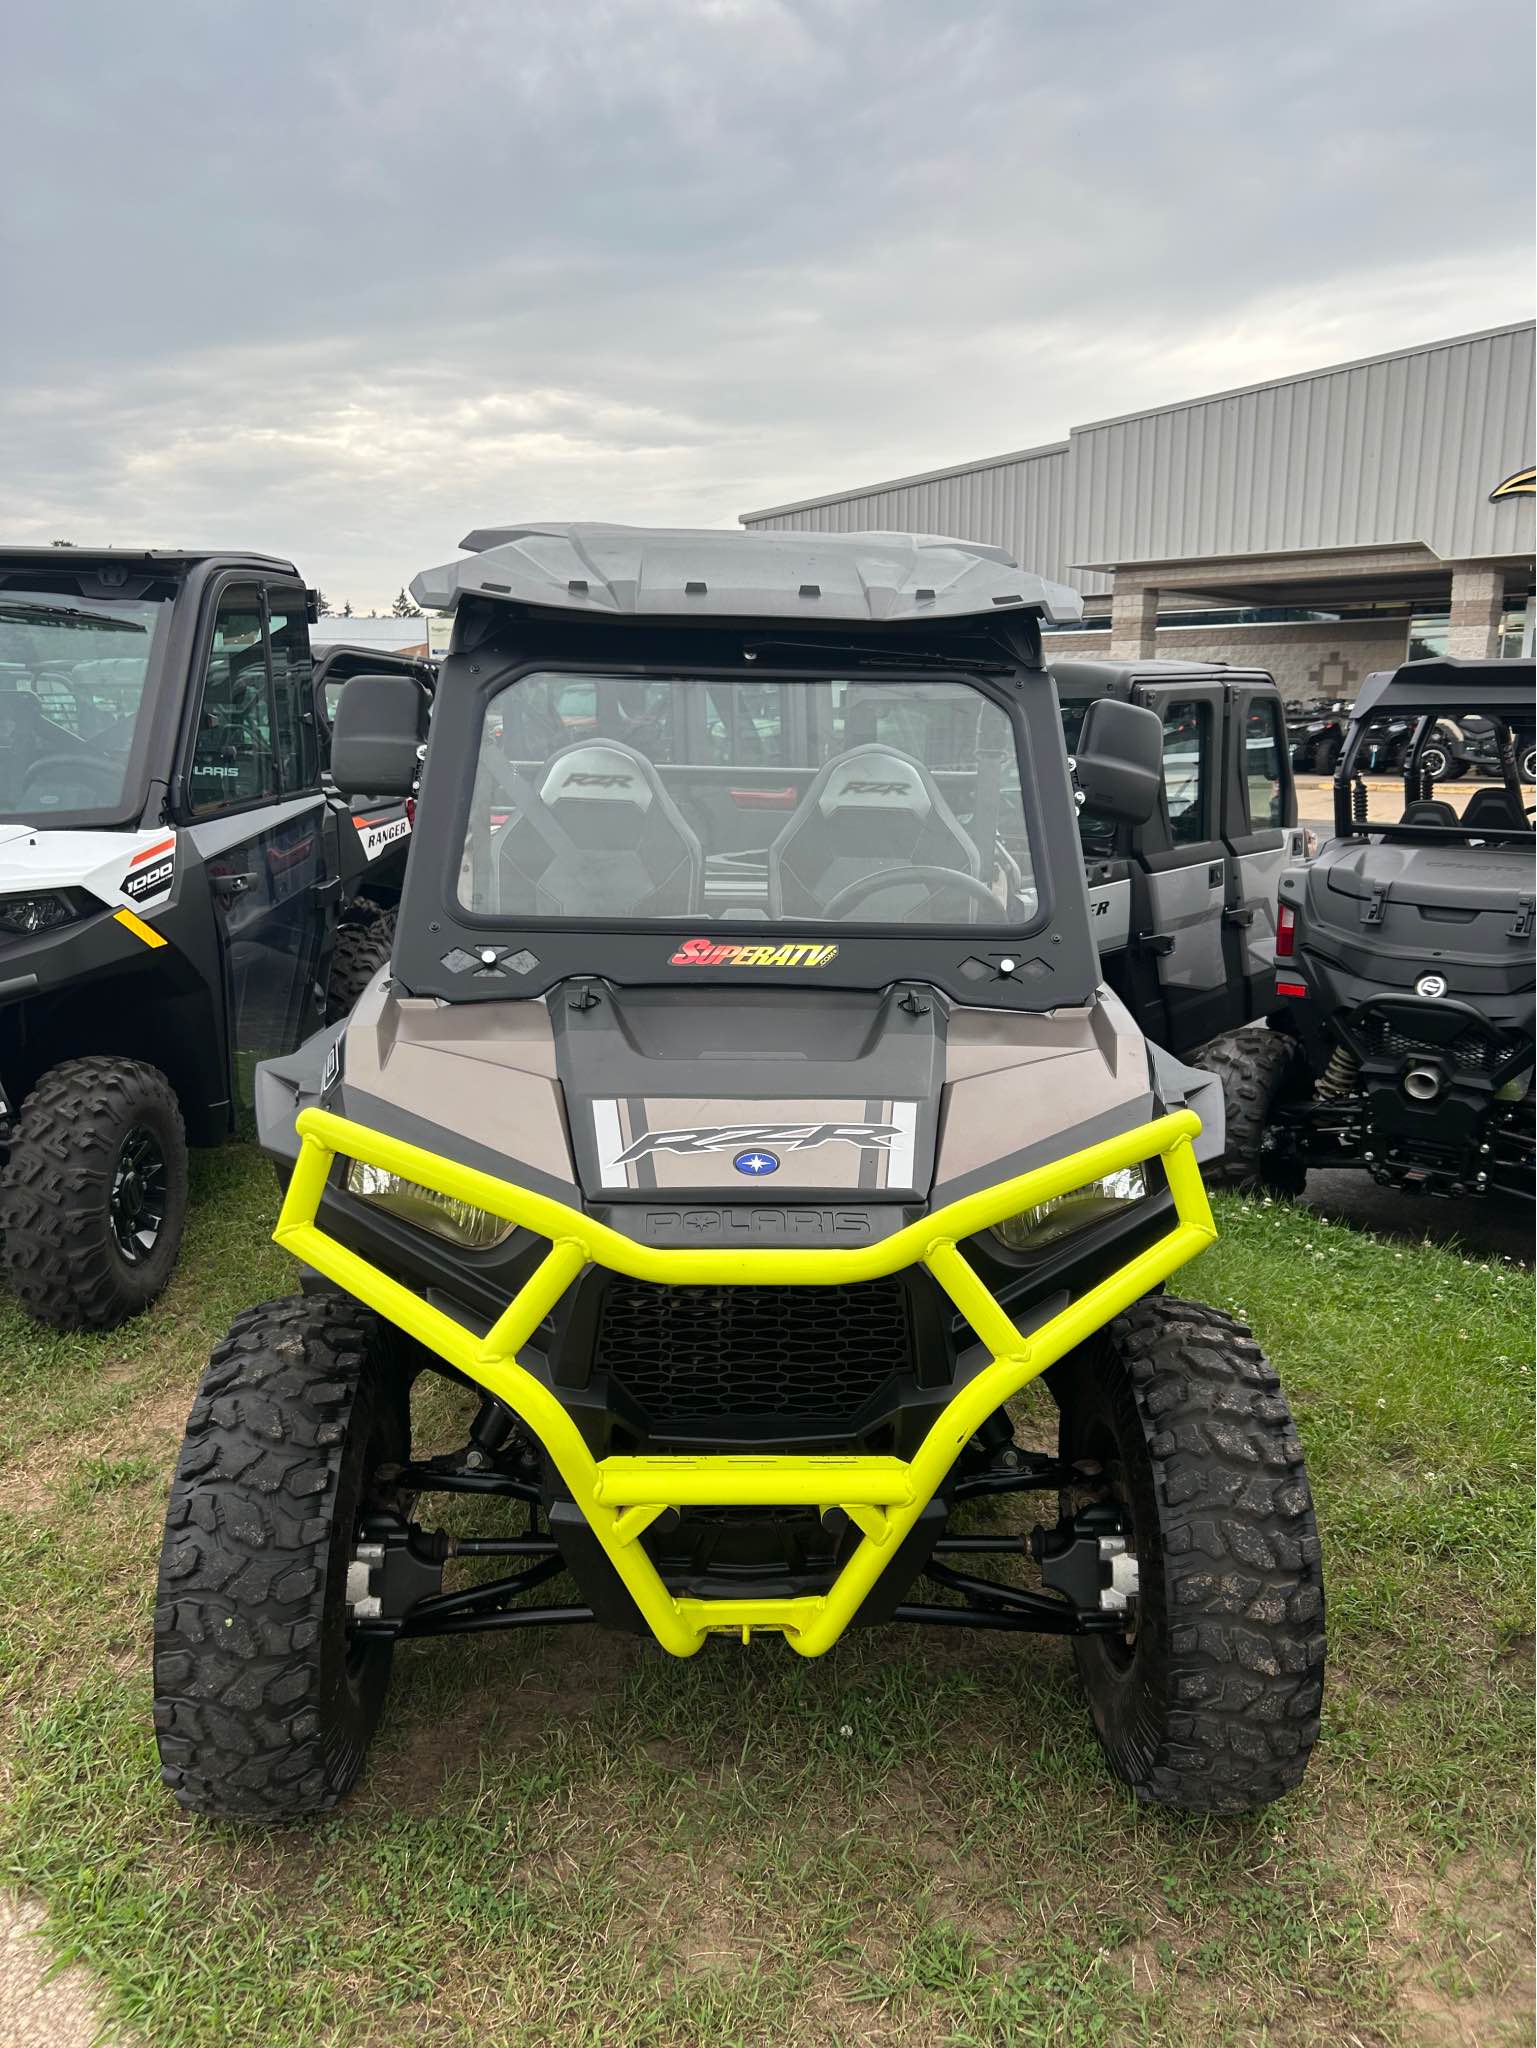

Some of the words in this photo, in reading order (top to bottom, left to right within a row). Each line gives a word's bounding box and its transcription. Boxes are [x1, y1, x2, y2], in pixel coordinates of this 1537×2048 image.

[193, 766, 239, 777] LARIS
[561, 773, 634, 789] RZR
[838, 782, 912, 797] RZR
[367, 821, 406, 848] RANGER
[127, 862, 172, 893] 1000
[605, 1122, 910, 1168] RZR
[646, 1209, 871, 1233] POLARIS
